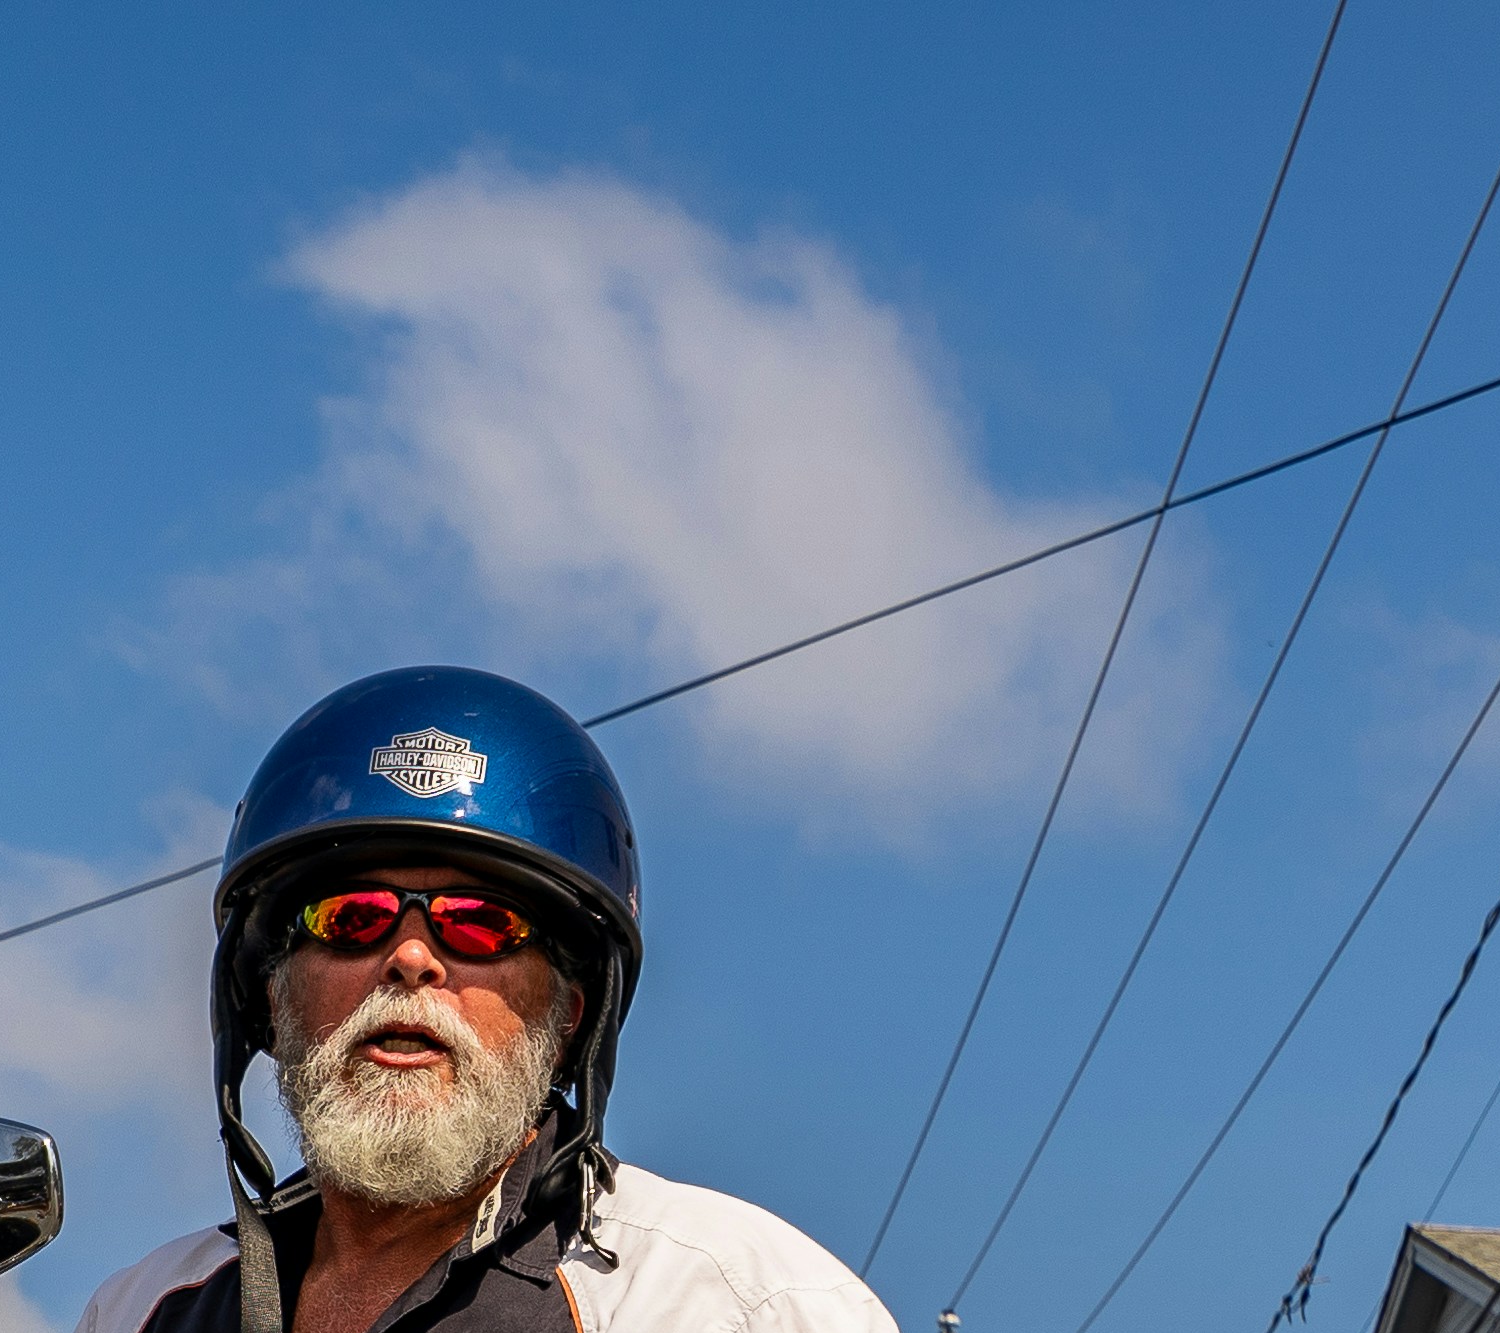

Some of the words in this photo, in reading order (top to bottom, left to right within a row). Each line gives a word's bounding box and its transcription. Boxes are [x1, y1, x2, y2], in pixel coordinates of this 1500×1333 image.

[404, 736, 457, 751] MOTOR
[379, 752, 476, 774] HARLEY-DAVIDSON
[399, 769, 454, 791] CYCLES
